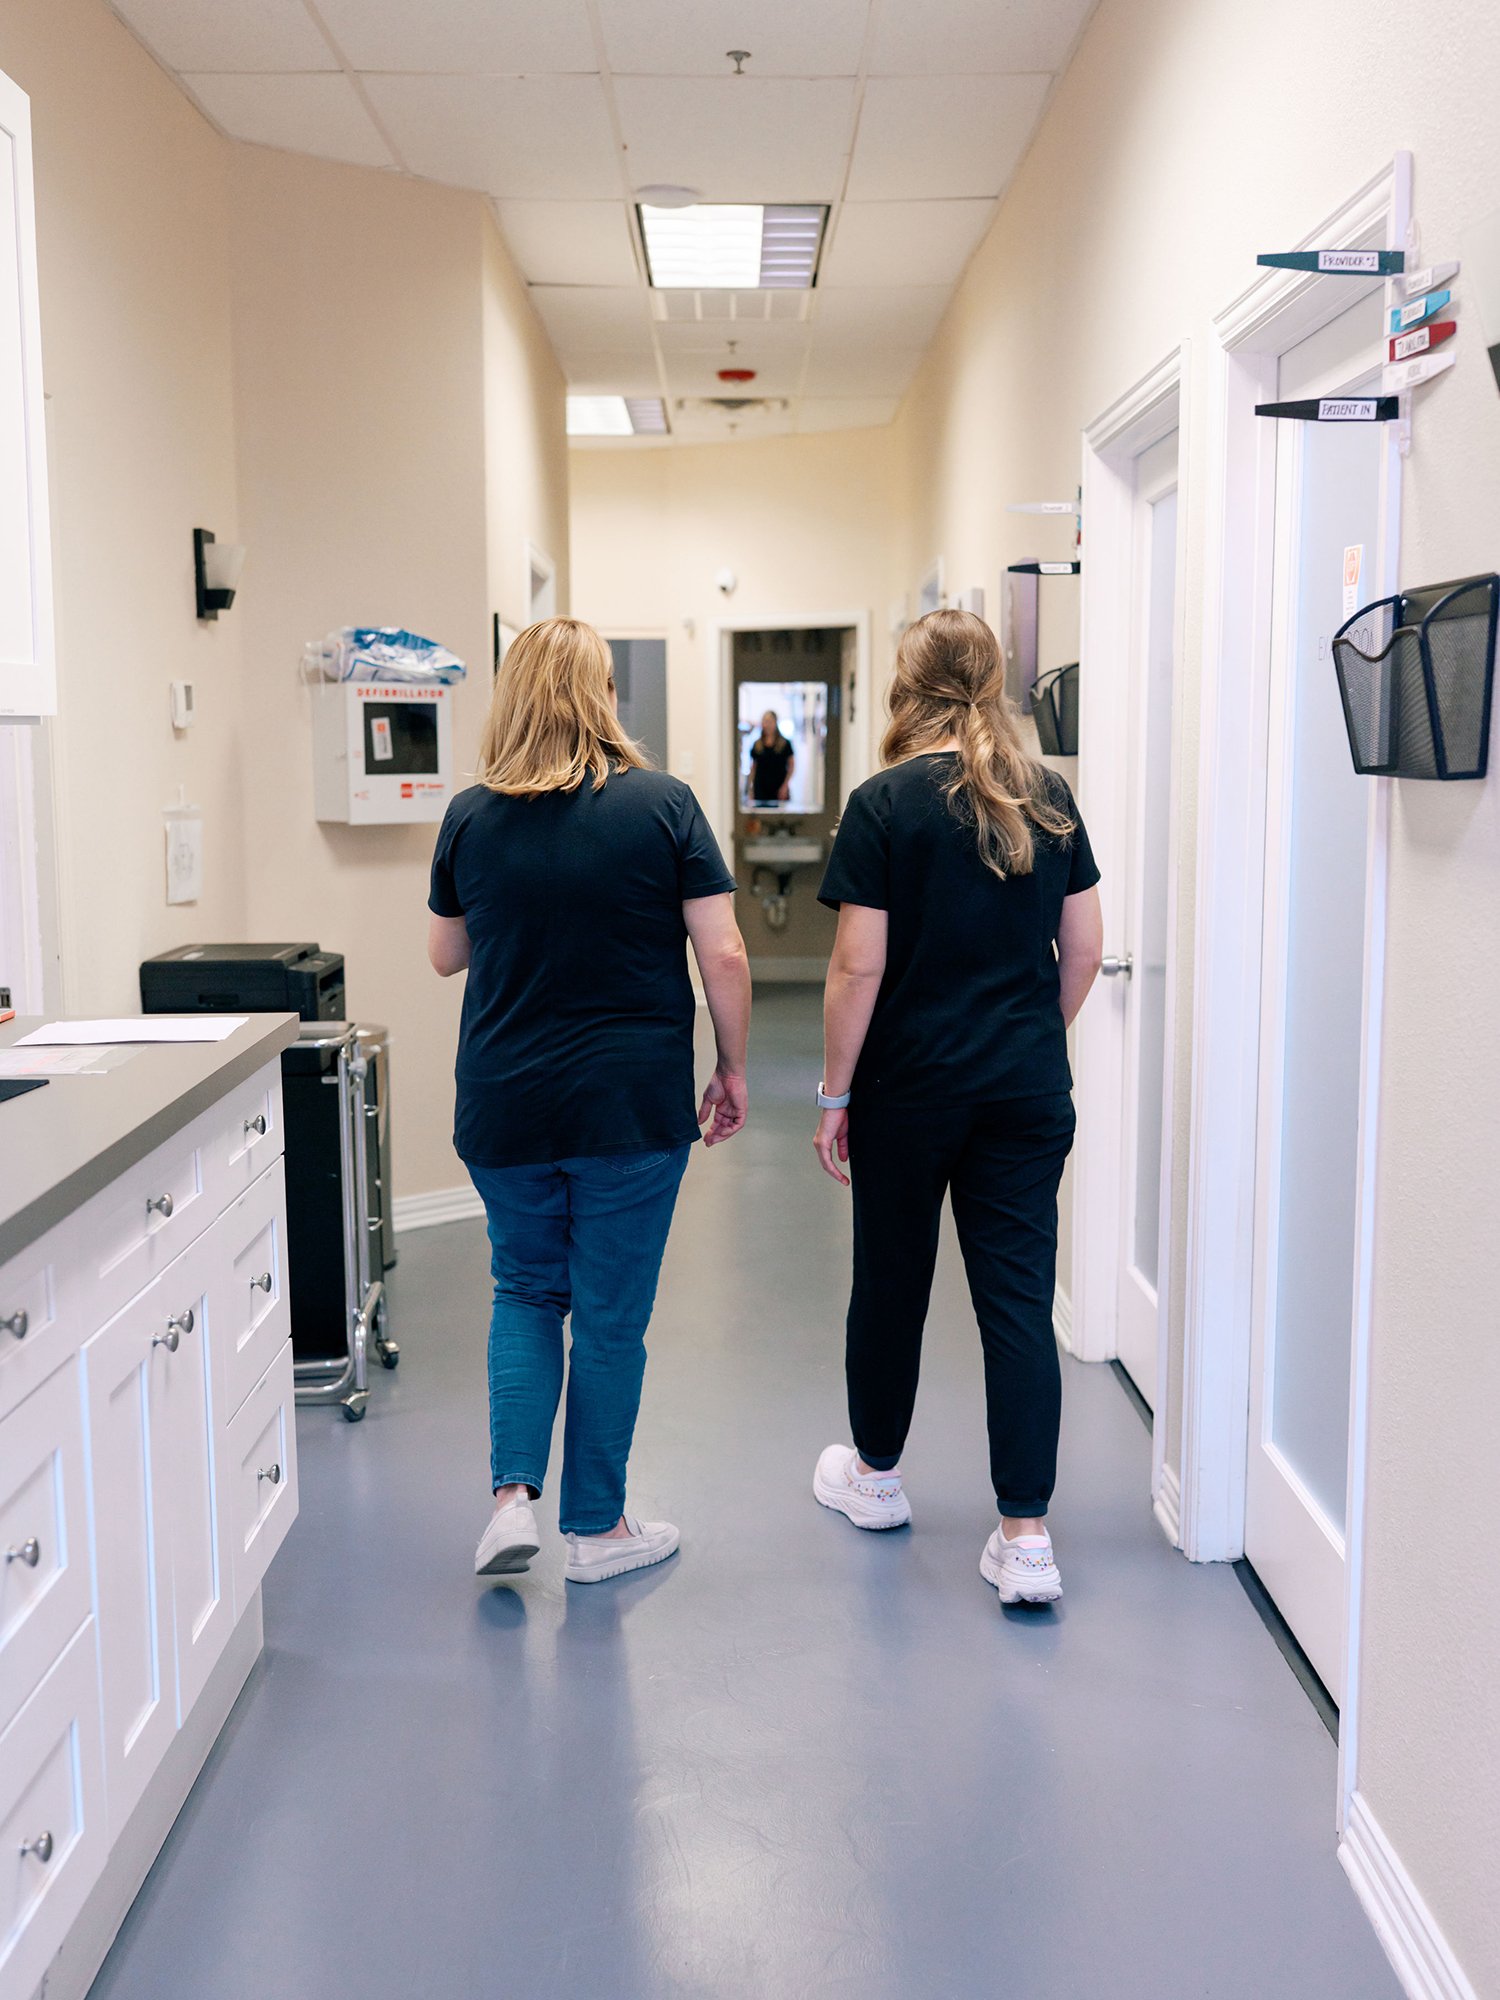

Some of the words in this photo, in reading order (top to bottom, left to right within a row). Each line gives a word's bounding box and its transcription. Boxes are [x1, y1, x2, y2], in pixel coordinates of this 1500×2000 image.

[1323, 255, 1364, 266] PROVIDER
[1322, 403, 1358, 416] PATIENT
[1360, 404, 1371, 415] IN
[357, 687, 444, 698] DEFIBRILLATOR
